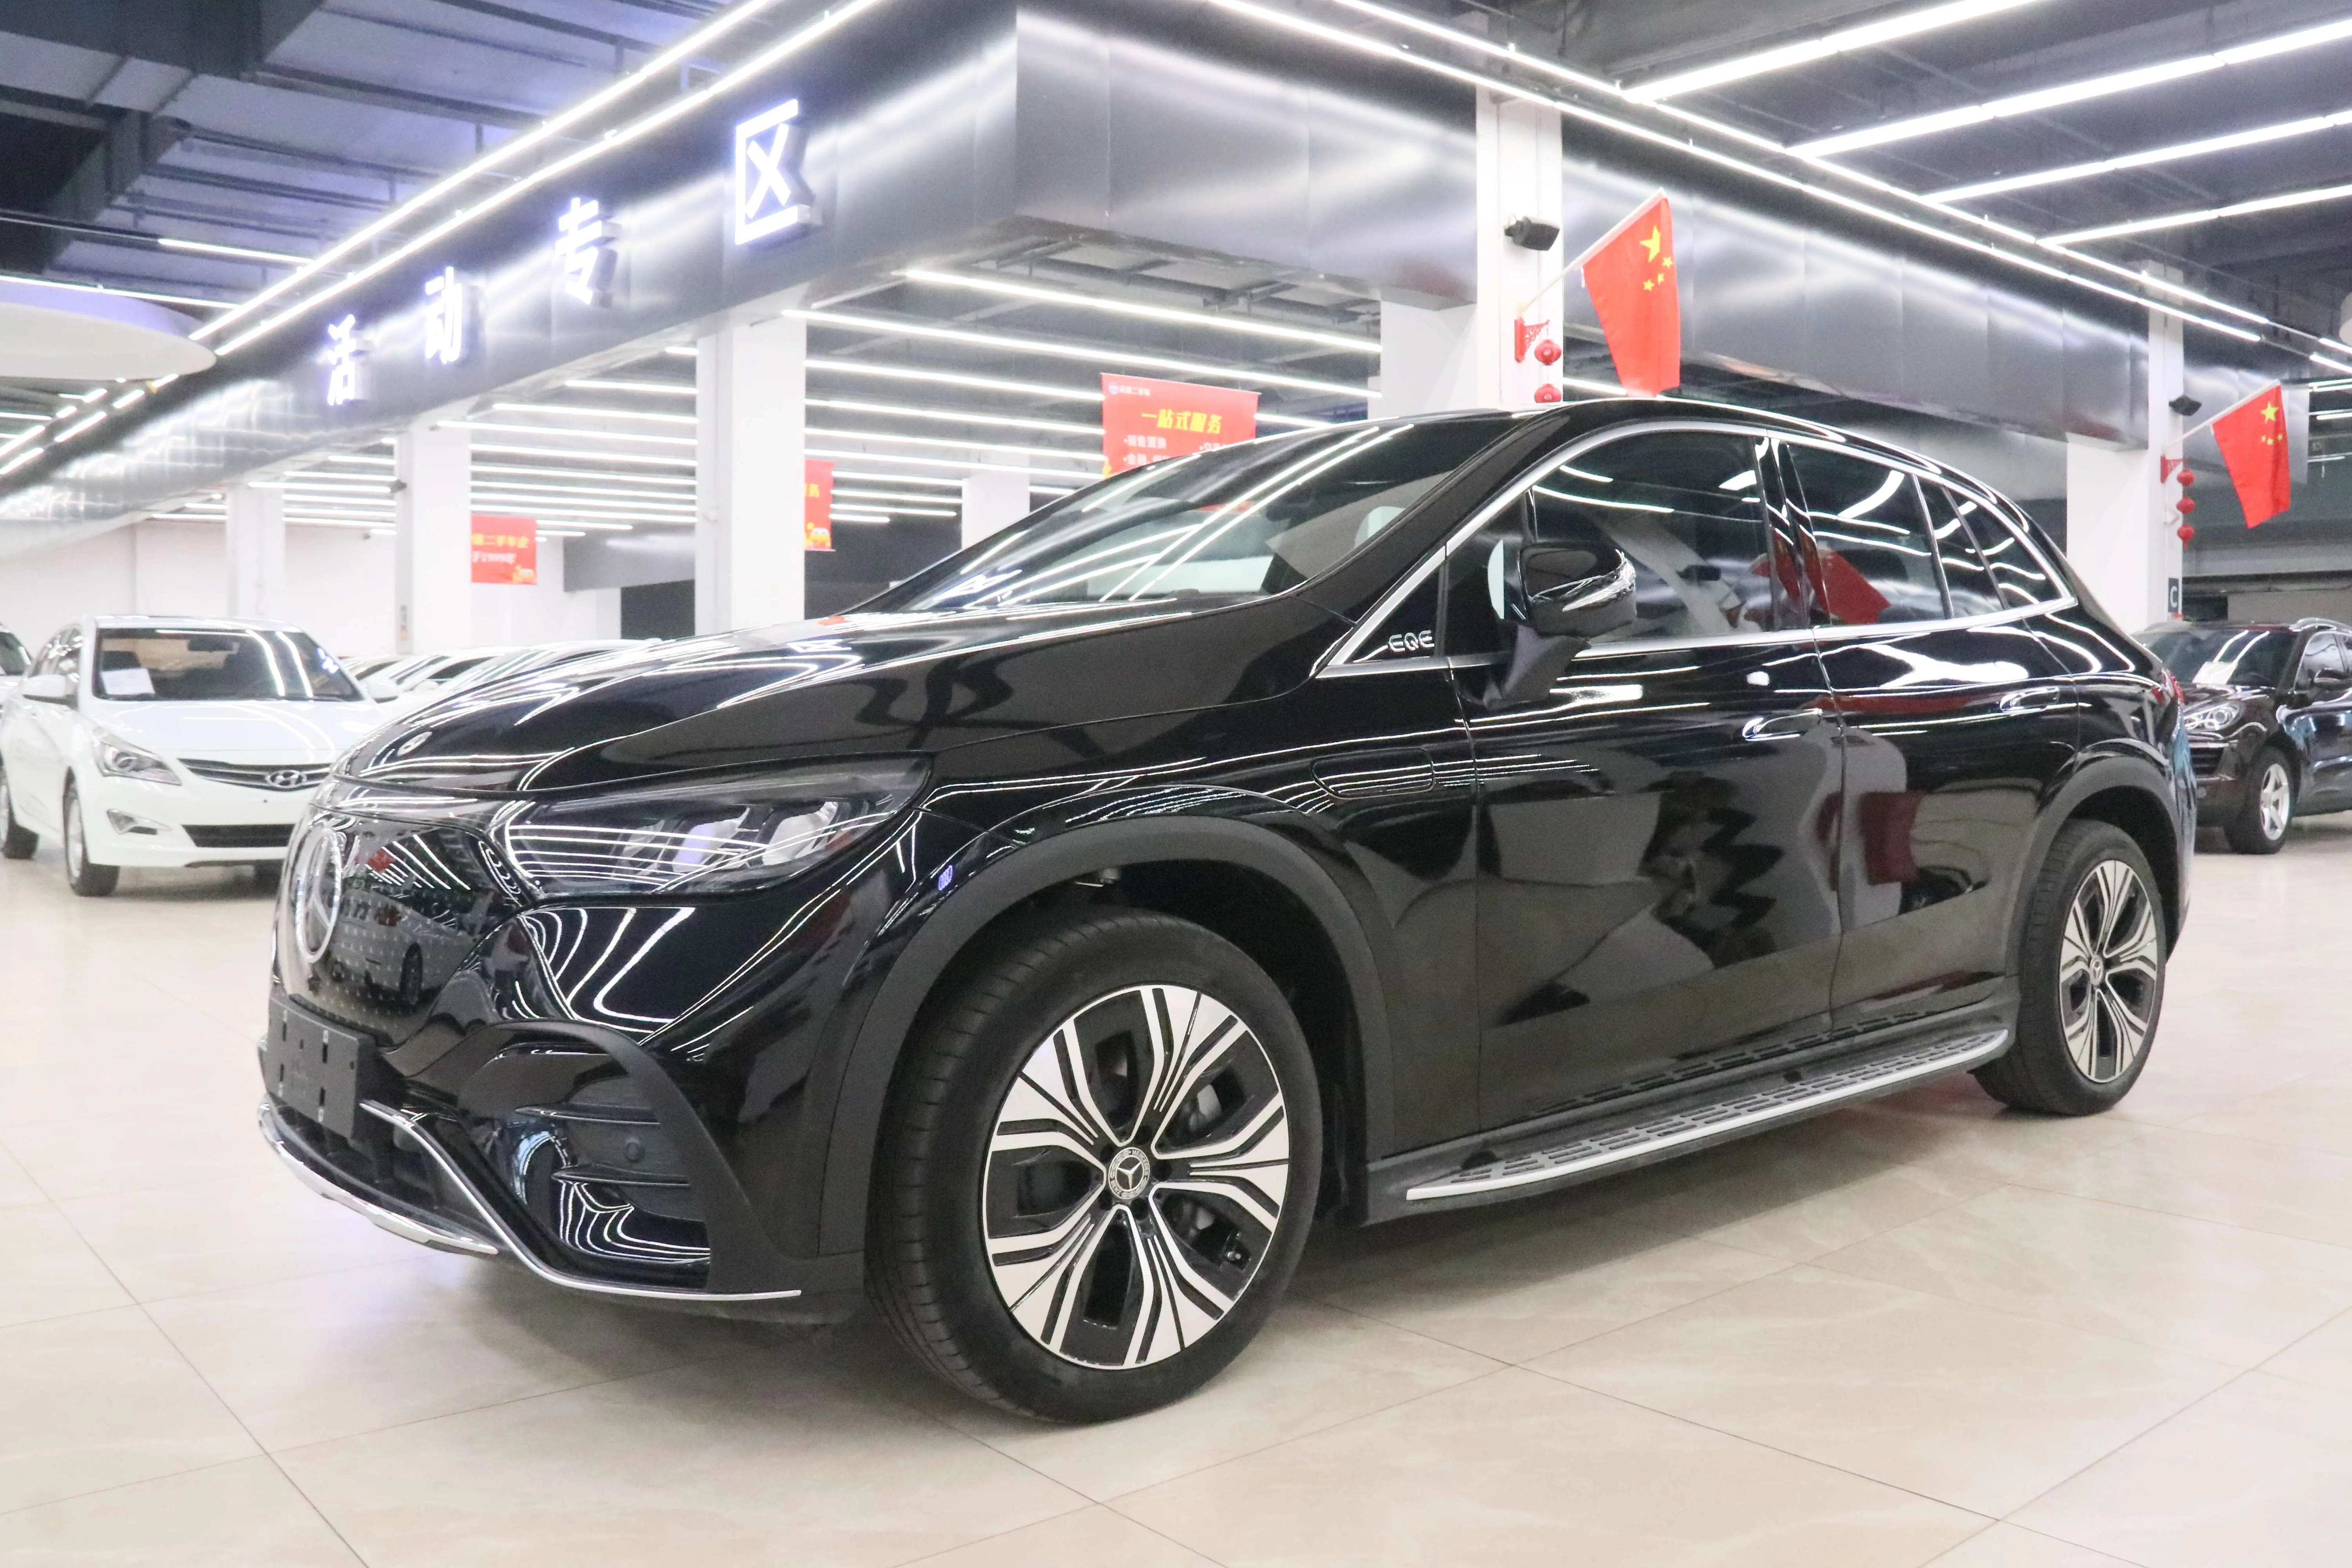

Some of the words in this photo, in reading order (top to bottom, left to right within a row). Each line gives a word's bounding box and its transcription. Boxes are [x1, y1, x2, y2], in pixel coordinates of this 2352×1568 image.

[328, 97, 799, 406] 活动专区
[1141, 408, 1222, 434] 一站式服务
[2170, 585, 2178, 608] C
[1388, 630, 1435, 652] EQE
